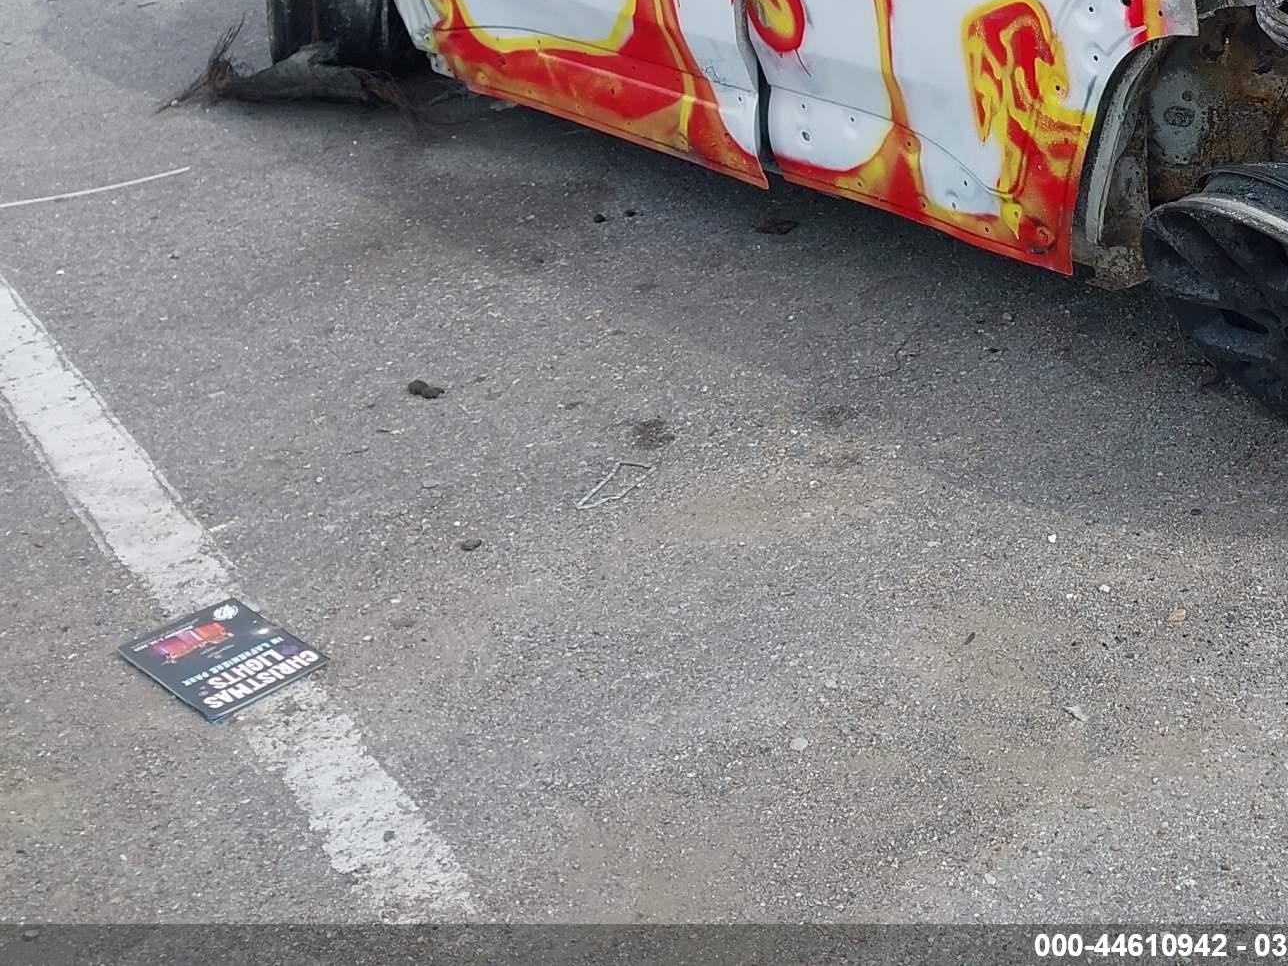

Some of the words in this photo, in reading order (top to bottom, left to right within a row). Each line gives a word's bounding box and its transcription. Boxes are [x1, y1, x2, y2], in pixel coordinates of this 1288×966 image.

[269, 636, 284, 645] IN
[181, 670, 210, 687] PARK
[203, 650, 319, 709] CHRISTMAS
[207, 649, 285, 689] LIGHTS
